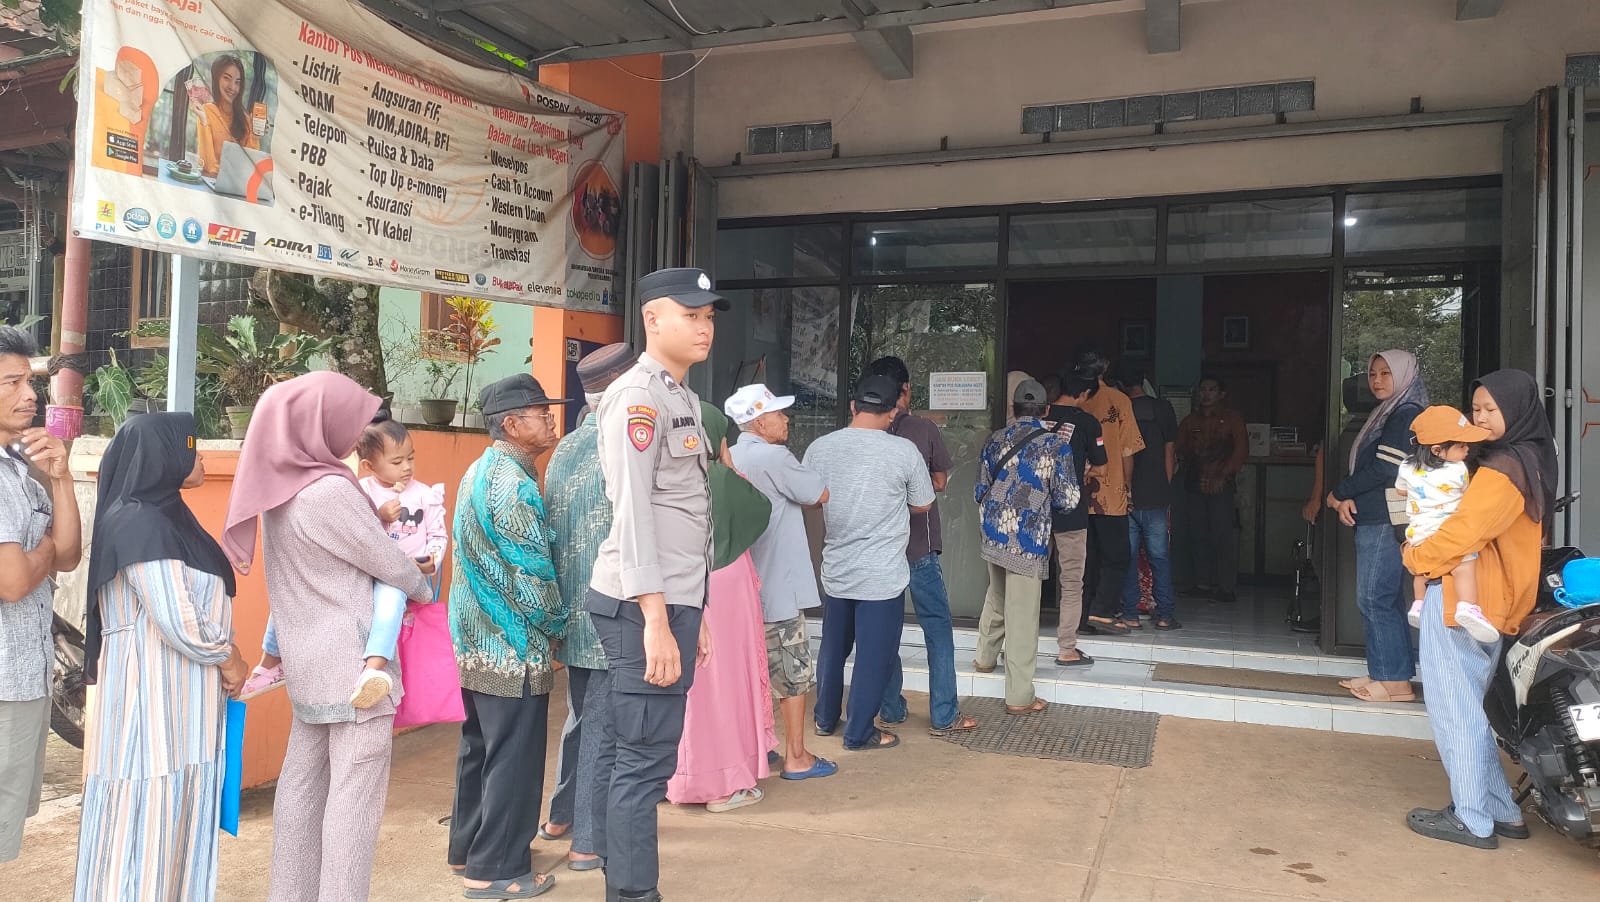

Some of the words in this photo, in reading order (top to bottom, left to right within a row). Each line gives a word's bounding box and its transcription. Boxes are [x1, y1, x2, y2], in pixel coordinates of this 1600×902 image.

[125, 5, 142, 17] dan
[298, 21, 340, 54] Kantor
[342, 42, 363, 65] Pos
[302, 54, 341, 86] Listrik
[300, 84, 336, 114] PDAM
[371, 81, 422, 115] Angsuran
[424, 100, 442, 124] FIF,
[536, 94, 570, 113] POSPAY
[303, 113, 348, 145] Telepon
[492, 105, 529, 130] Menerima
[434, 130, 451, 152] BFI
[487, 124, 512, 145] Dalam
[512, 132, 526, 152] dan
[300, 142, 328, 167] PBB
[367, 136, 397, 162] Pulsa
[400, 145, 408, 162] &
[411, 149, 434, 171] Data
[490, 149, 529, 175] Weselpos
[298, 171, 333, 199] Pajak
[369, 162, 387, 188] Top
[390, 168, 404, 192] Up
[407, 175, 448, 203] e-money
[491, 173, 511, 194] Cash
[513, 178, 522, 197] To
[523, 182, 554, 203] Account
[365, 190, 413, 217] Asuransi
[491, 195, 524, 220] Western
[525, 204, 547, 224] Union
[95, 222, 116, 233] PLN
[299, 203, 345, 233] e-Tilang
[365, 216, 380, 236] TV
[382, 220, 413, 242] Kabel
[490, 219, 539, 243] Moneygram
[264, 237, 313, 254] ADIRA
[527, 281, 562, 296] elevenia
[566, 287, 601, 302] tokopedia
[1572, 708, 1584, 721] Z
